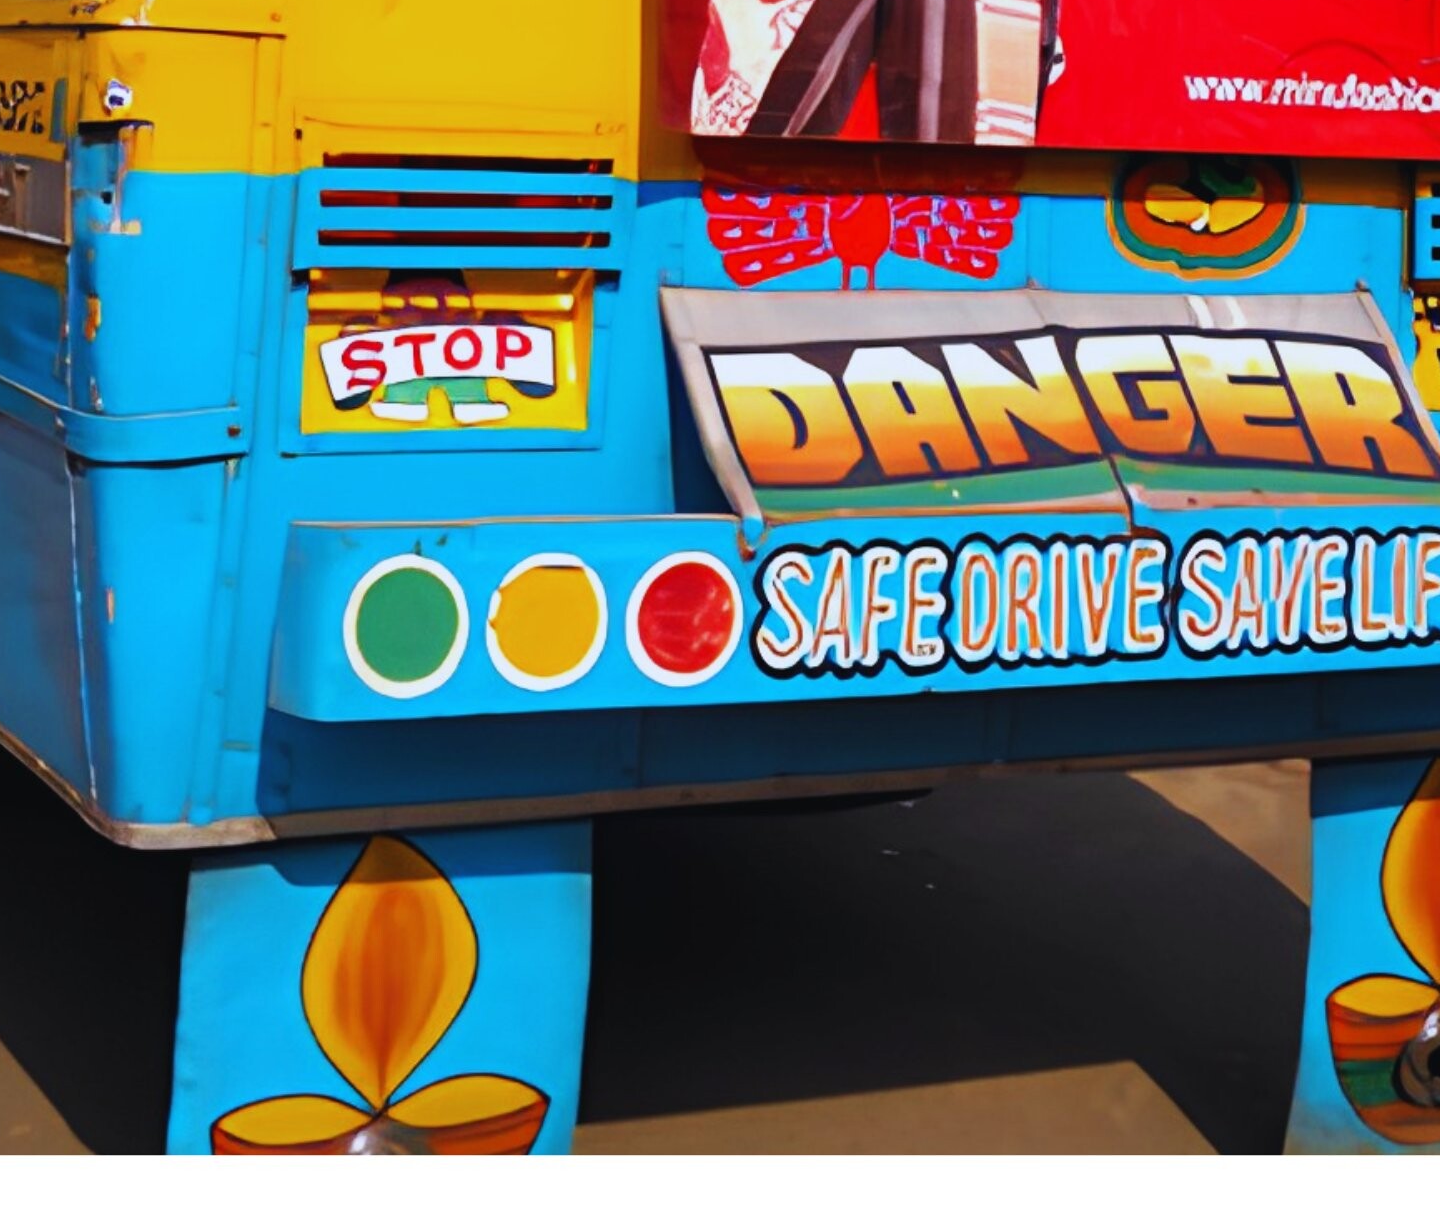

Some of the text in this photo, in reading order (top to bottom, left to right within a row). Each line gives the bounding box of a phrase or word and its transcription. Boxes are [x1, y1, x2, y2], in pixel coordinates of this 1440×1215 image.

[340, 326, 533, 391] STOP
[707, 333, 1423, 487] DANGER
[757, 545, 948, 669] SAFE
[959, 537, 1167, 662] DRIVE
[1178, 534, 1349, 651] SAVE
